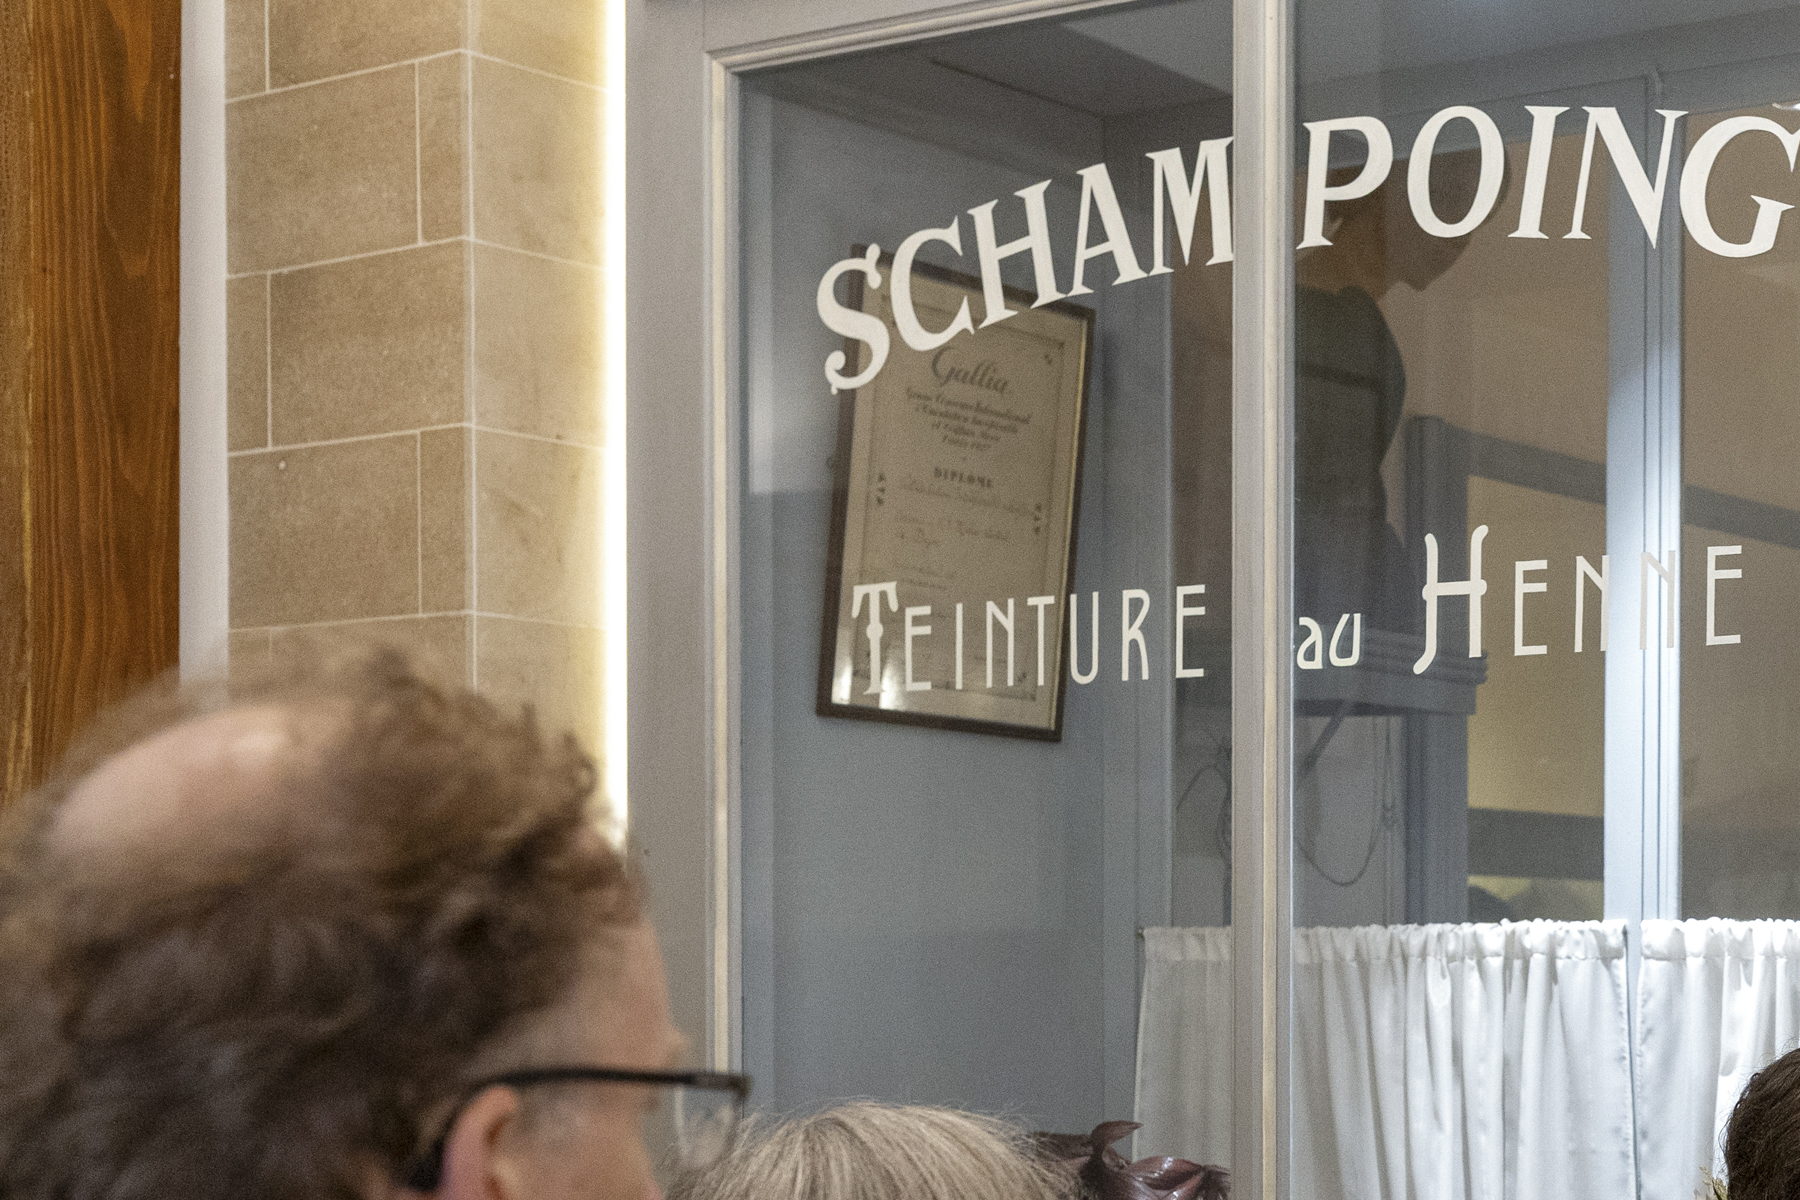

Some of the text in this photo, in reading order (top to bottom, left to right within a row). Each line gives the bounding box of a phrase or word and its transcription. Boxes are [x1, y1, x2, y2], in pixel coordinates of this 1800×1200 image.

[850, 524, 1744, 696] TEINTURE au HENNE
